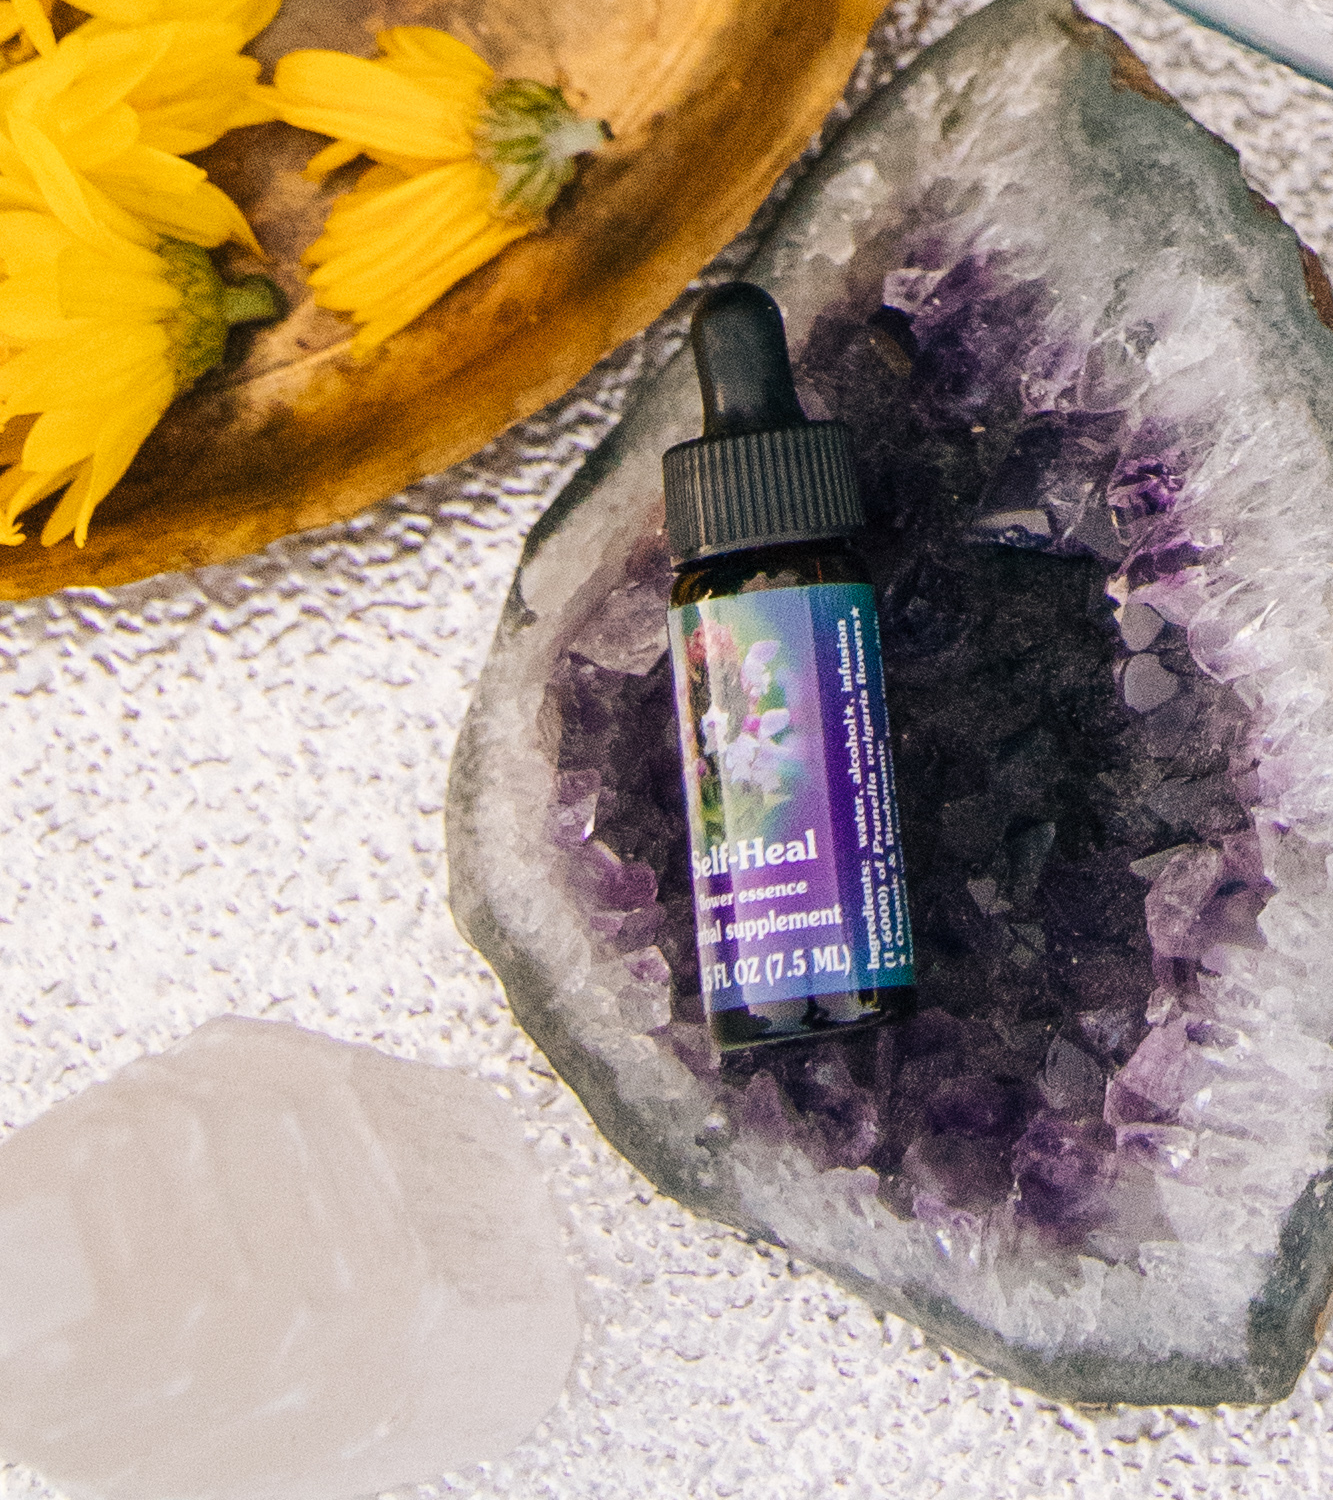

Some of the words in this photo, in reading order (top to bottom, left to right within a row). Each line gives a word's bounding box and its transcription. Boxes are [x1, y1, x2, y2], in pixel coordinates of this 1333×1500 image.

[836, 618, 853, 693] infusion
[858, 689, 875, 766] vulgaris
[854, 789, 868, 849] water,
[866, 771, 884, 854] Prunella
[692, 828, 819, 880] Self-Heal
[874, 860, 887, 881] of
[738, 880, 809, 904] essence
[860, 858, 881, 970] Ingredients:
[724, 904, 844, 942] supplement
[876, 885, 897, 969] (1:6000)
[714, 962, 732, 991] FL
[733, 956, 761, 987] OZ
[766, 948, 807, 986] (7.5
[811, 944, 852, 977] ML)
